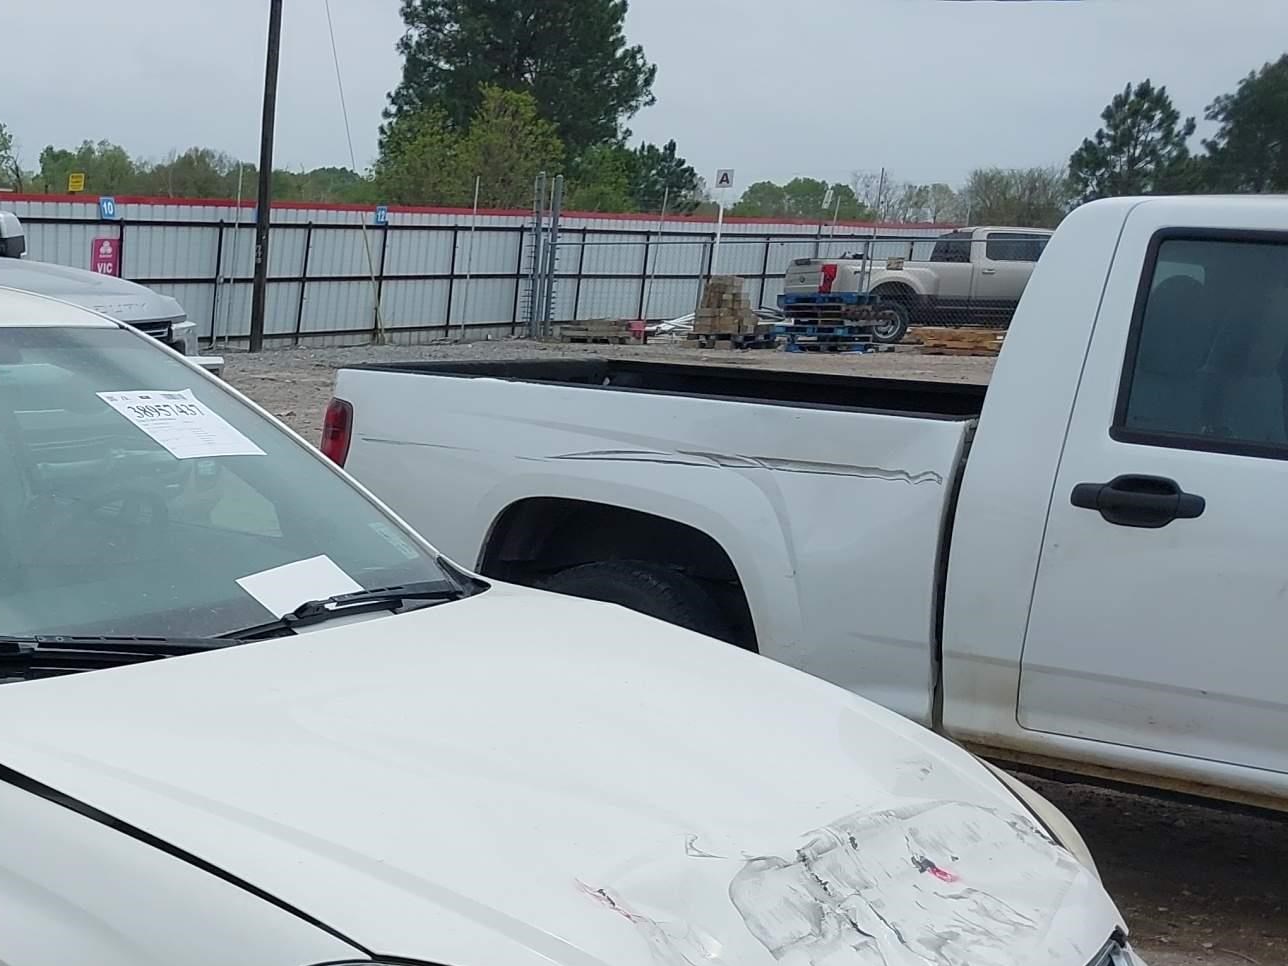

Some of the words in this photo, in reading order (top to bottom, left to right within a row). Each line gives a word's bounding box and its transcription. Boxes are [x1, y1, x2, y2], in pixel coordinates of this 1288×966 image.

[719, 172, 729, 184] A
[102, 202, 114, 214] 10
[377, 211, 386, 222] 12
[127, 404, 205, 419] 38957437
